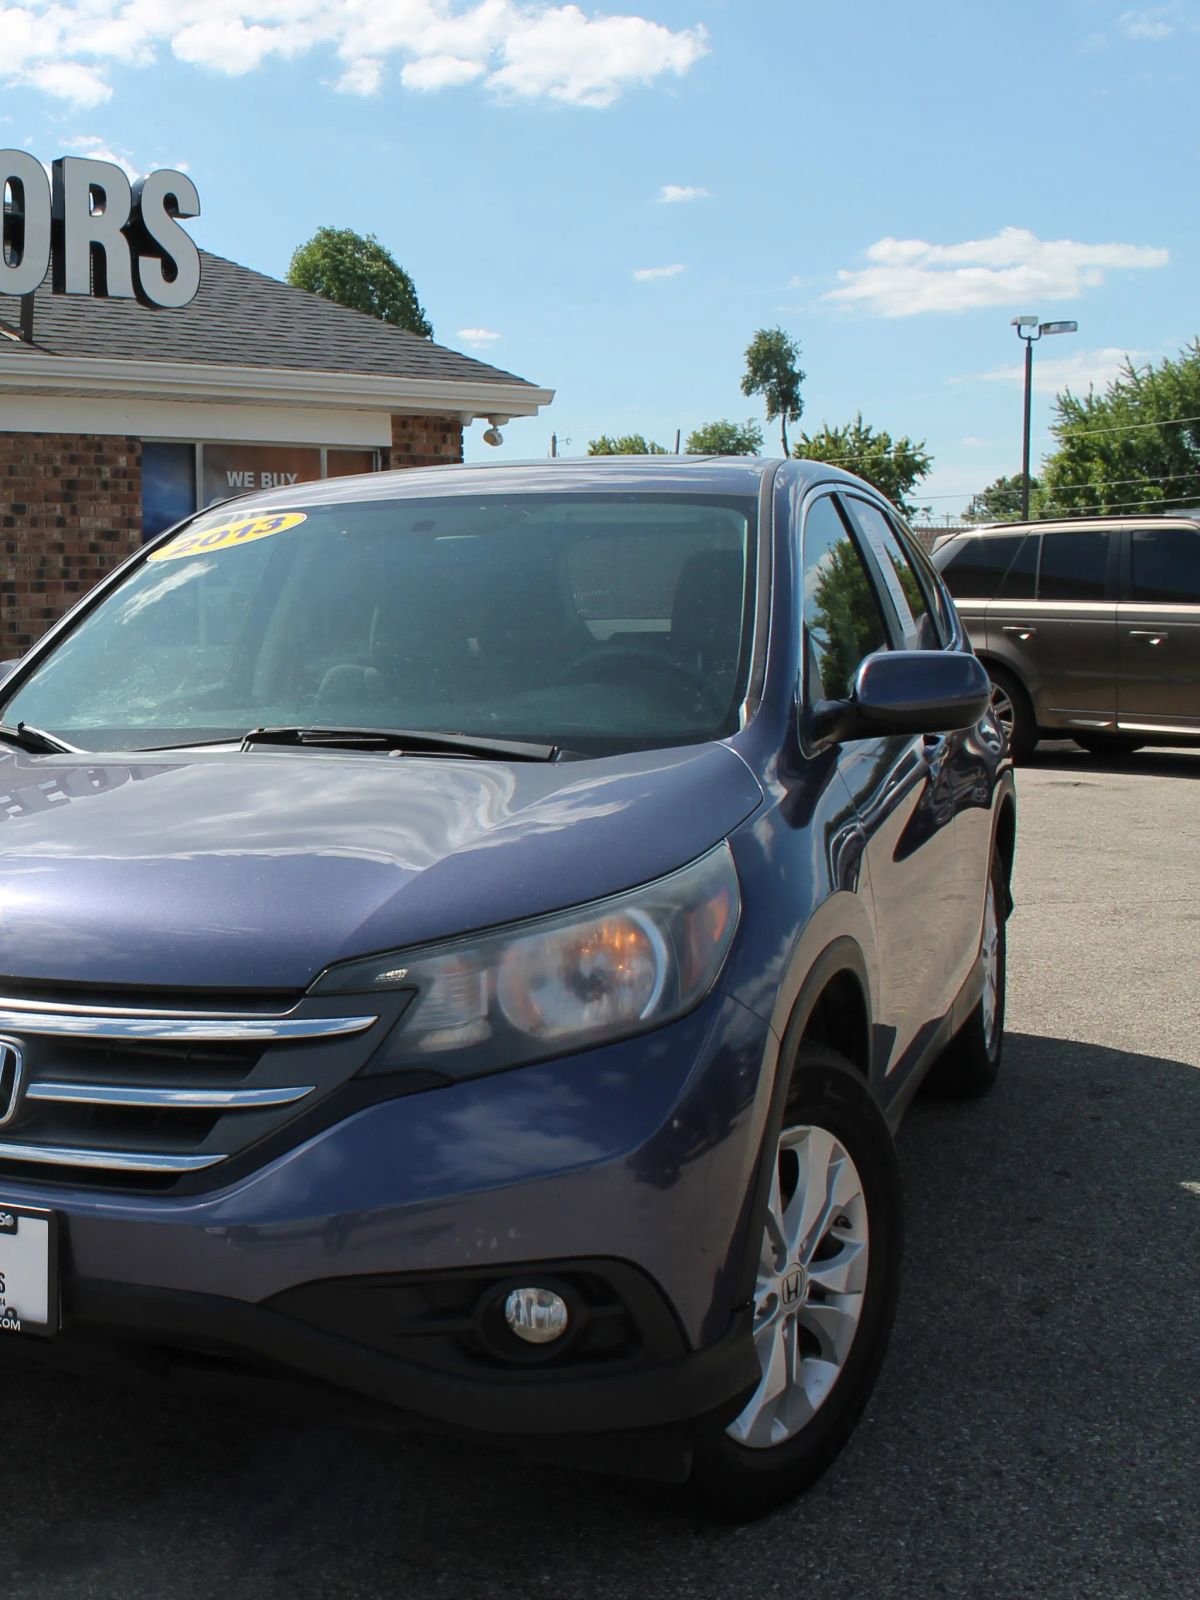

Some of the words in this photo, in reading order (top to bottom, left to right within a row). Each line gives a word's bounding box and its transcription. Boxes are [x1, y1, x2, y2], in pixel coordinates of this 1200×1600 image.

[226, 471, 255, 488] WE
[261, 472, 298, 489] BUY
[168, 516, 287, 555] 2013
